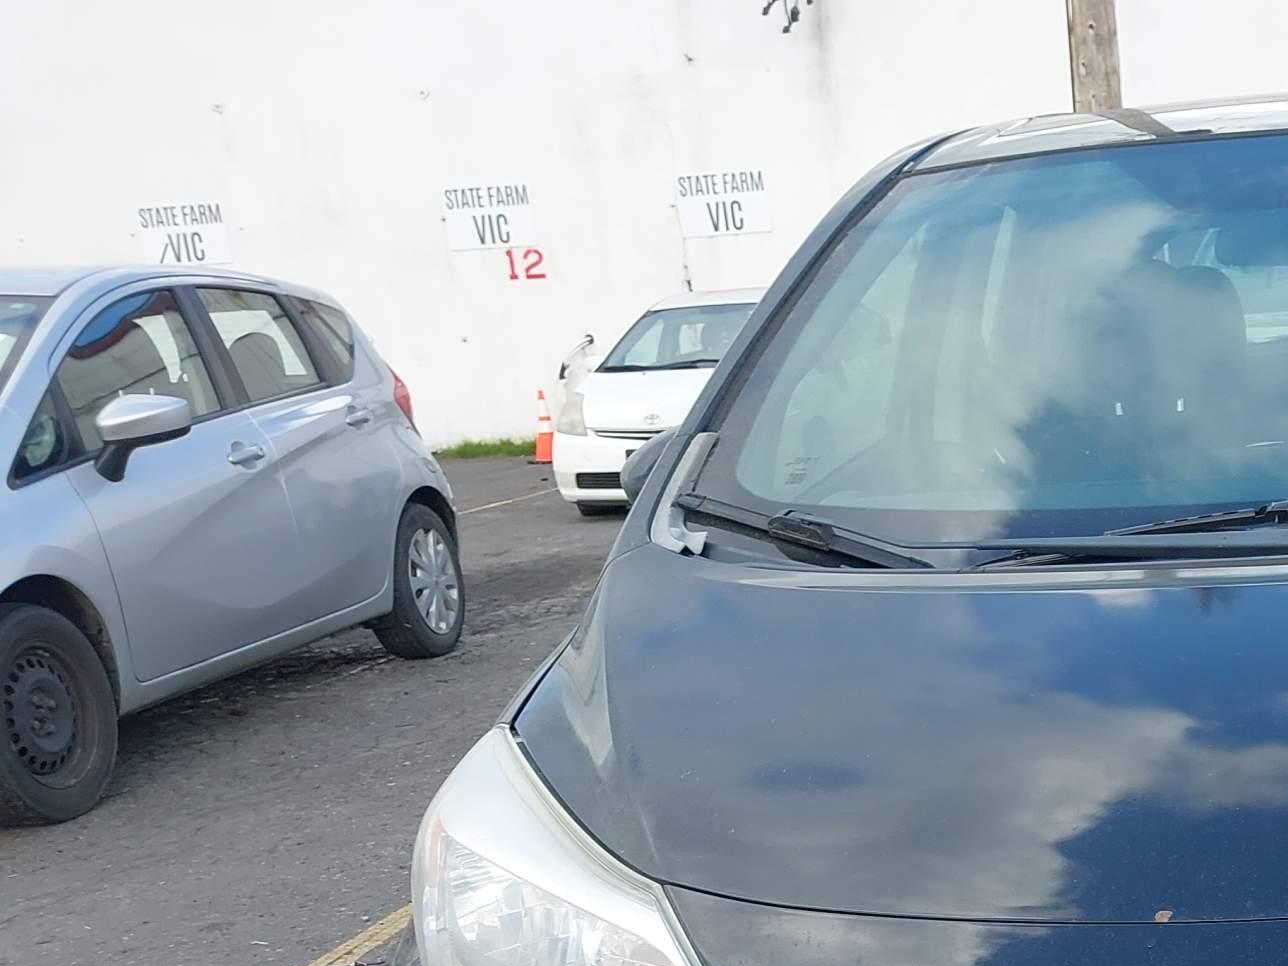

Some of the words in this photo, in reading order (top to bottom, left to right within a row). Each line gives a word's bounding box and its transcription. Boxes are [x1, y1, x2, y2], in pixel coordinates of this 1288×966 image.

[444, 187, 486, 210] STATE
[487, 185, 530, 207] FARM
[678, 173, 720, 197] STATE
[722, 171, 765, 193] FARM
[138, 206, 179, 228] STATE
[180, 203, 223, 226] FARM
[472, 214, 511, 245] VIC
[706, 200, 745, 232] VIC
[505, 248, 547, 280] 12
